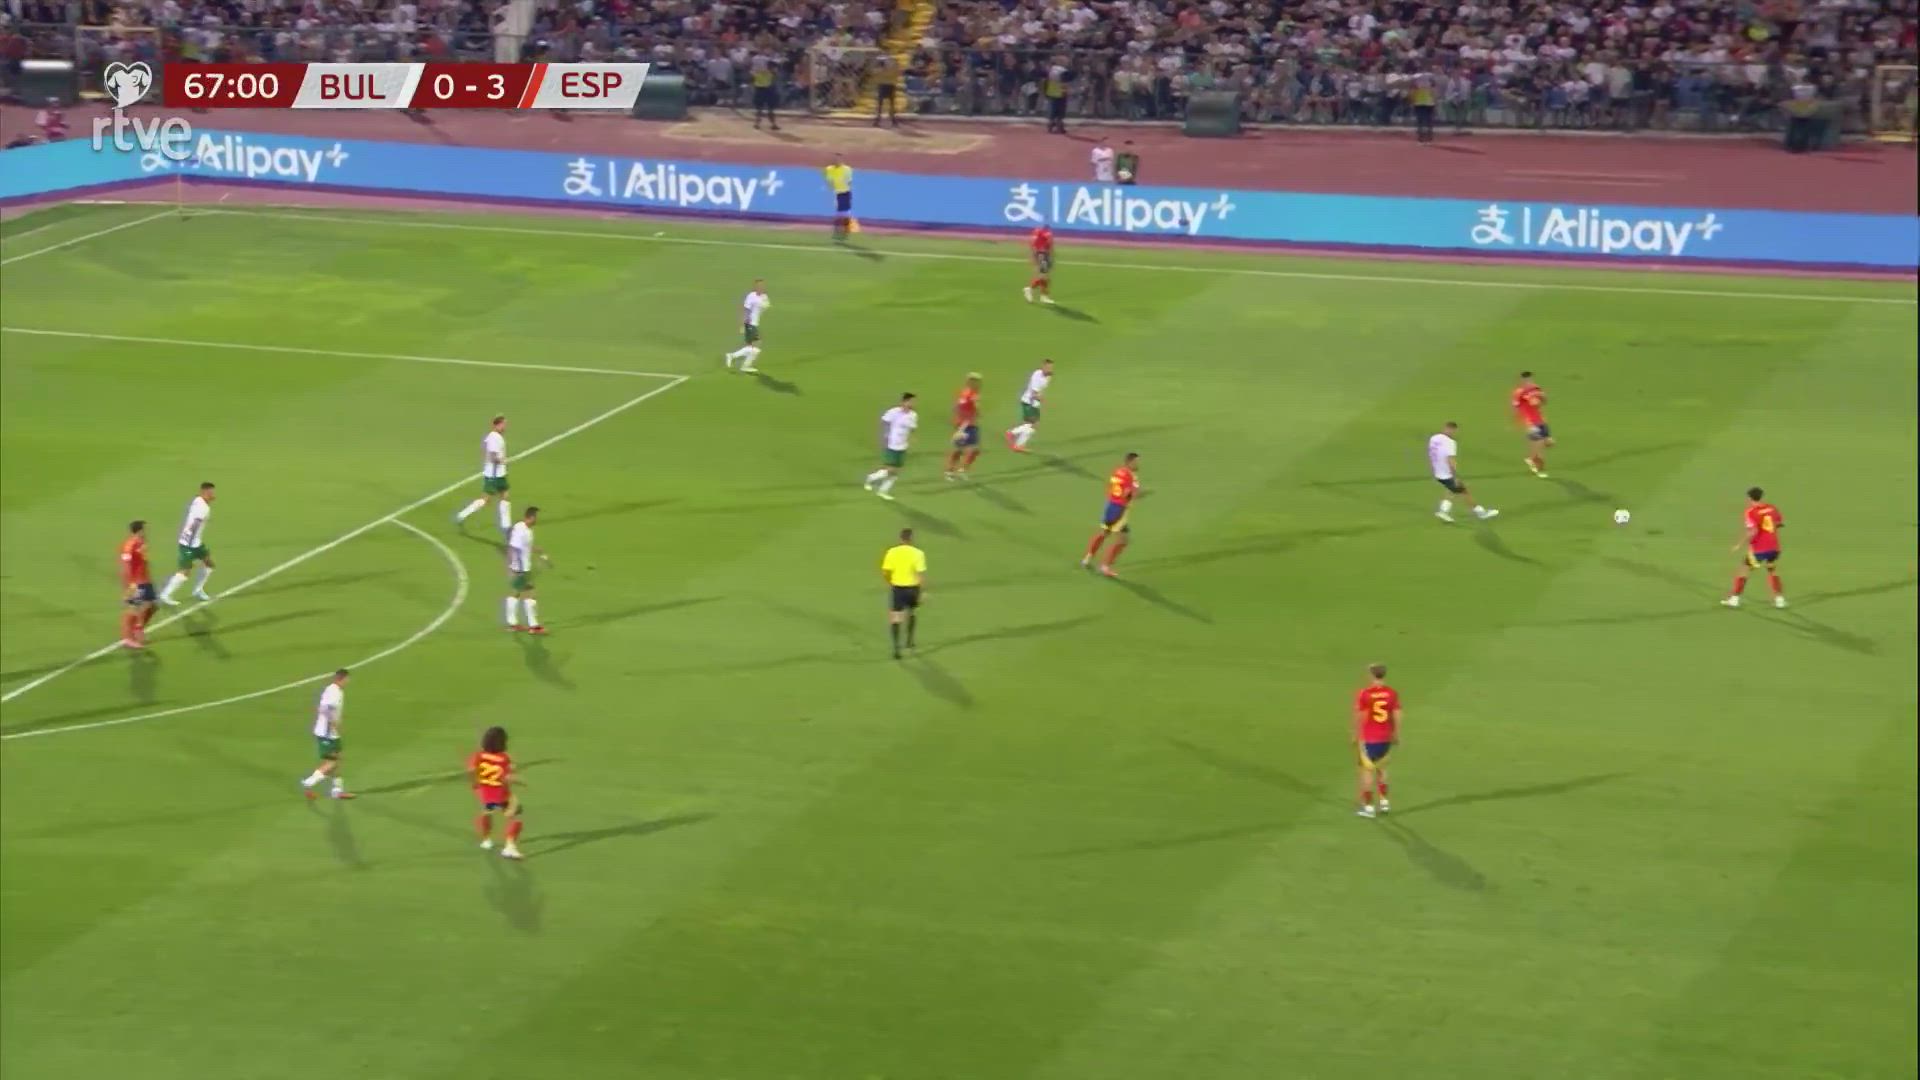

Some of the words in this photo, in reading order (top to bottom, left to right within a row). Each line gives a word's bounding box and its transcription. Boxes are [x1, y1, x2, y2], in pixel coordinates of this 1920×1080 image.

[1762, 515, 1774, 533] 4
[1373, 701, 1388, 723] 5
[479, 762, 504, 786] 22
